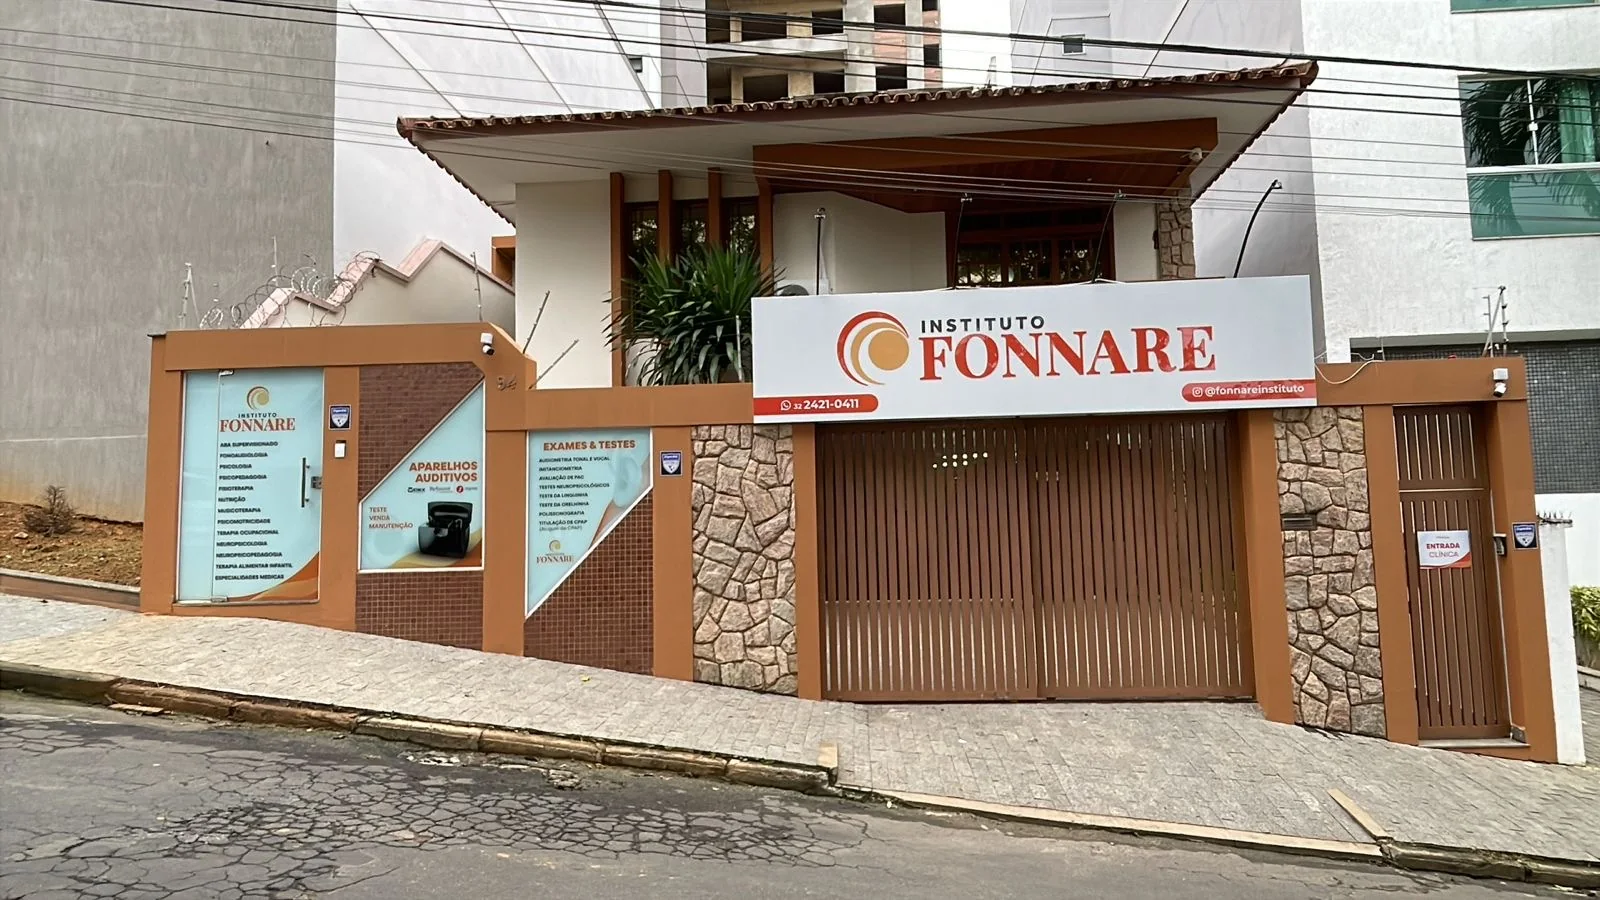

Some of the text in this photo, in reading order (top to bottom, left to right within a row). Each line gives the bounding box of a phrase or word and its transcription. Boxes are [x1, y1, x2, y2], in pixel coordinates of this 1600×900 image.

[920, 315, 1045, 334] INSTITUTO
[918, 325, 1217, 381] FONNARE
[1205, 384, 1305, 398] @fonnareinstituto
[803, 399, 859, 410] 2421-0411
[219, 417, 296, 433] FONNARE
[543, 439, 636, 451] EXAMES & TESTES
[409, 461, 478, 471] APARELHOS
[415, 472, 478, 483] AUDITIVOS
[368, 521, 414, 530] MANUTENÇÃO
[1426, 542, 1461, 550] ENTRADA
[1428, 550, 1460, 558] CLÍNICA
